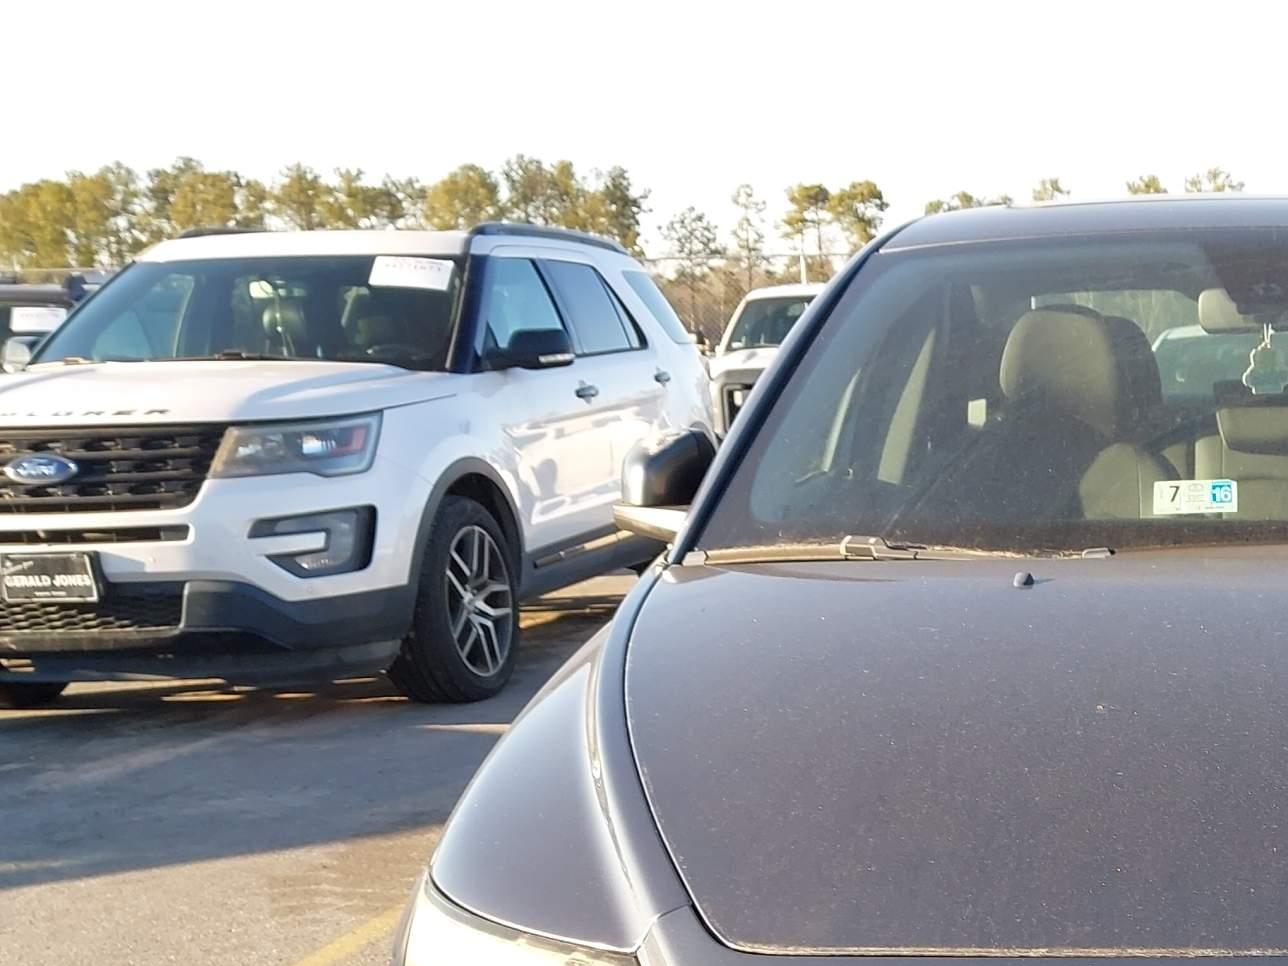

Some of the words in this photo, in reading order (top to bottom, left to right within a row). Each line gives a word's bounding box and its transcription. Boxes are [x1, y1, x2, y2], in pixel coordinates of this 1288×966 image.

[1168, 485, 1180, 503] 7
[1212, 485, 1233, 503] 16
[5, 574, 52, 588] GERALD
[52, 573, 92, 588] JONES
